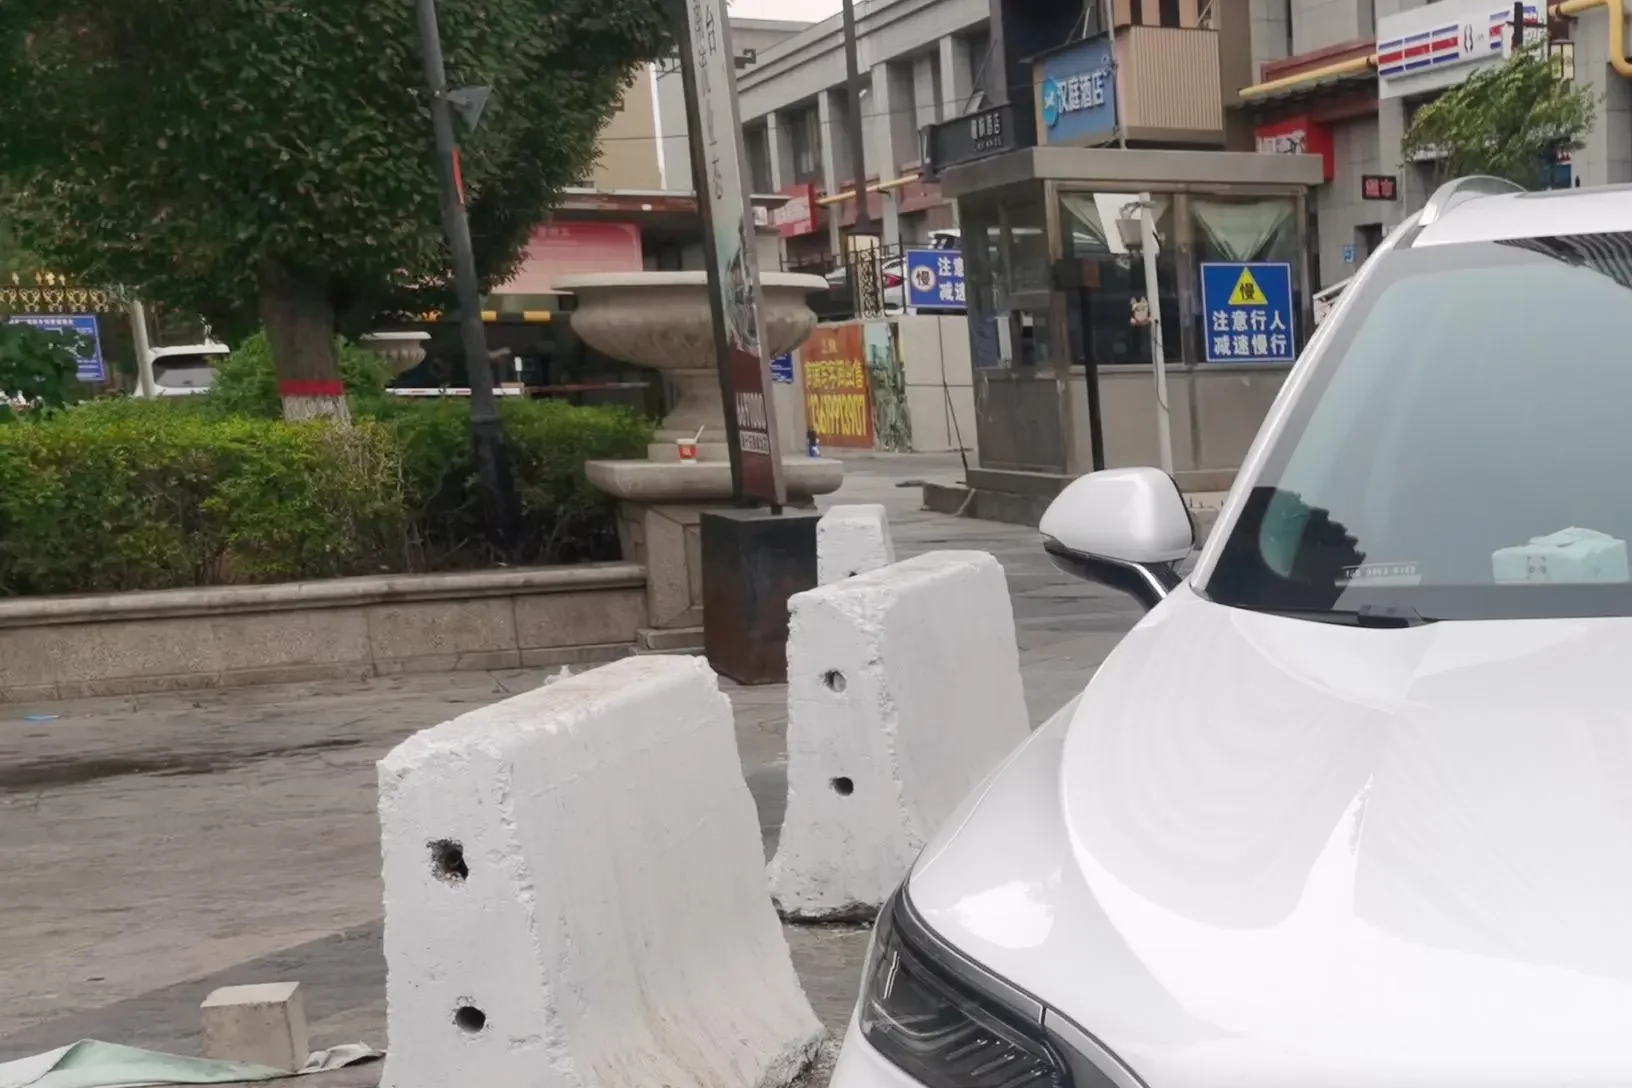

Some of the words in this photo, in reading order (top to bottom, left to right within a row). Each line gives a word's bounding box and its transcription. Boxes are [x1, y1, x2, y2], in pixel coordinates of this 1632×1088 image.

[1057, 70, 1106, 113] 汉庭酒店
[1239, 283, 1256, 300] 慢
[1213, 310, 1286, 331] 注意行人
[1214, 334, 1288, 355] 减速慢行
